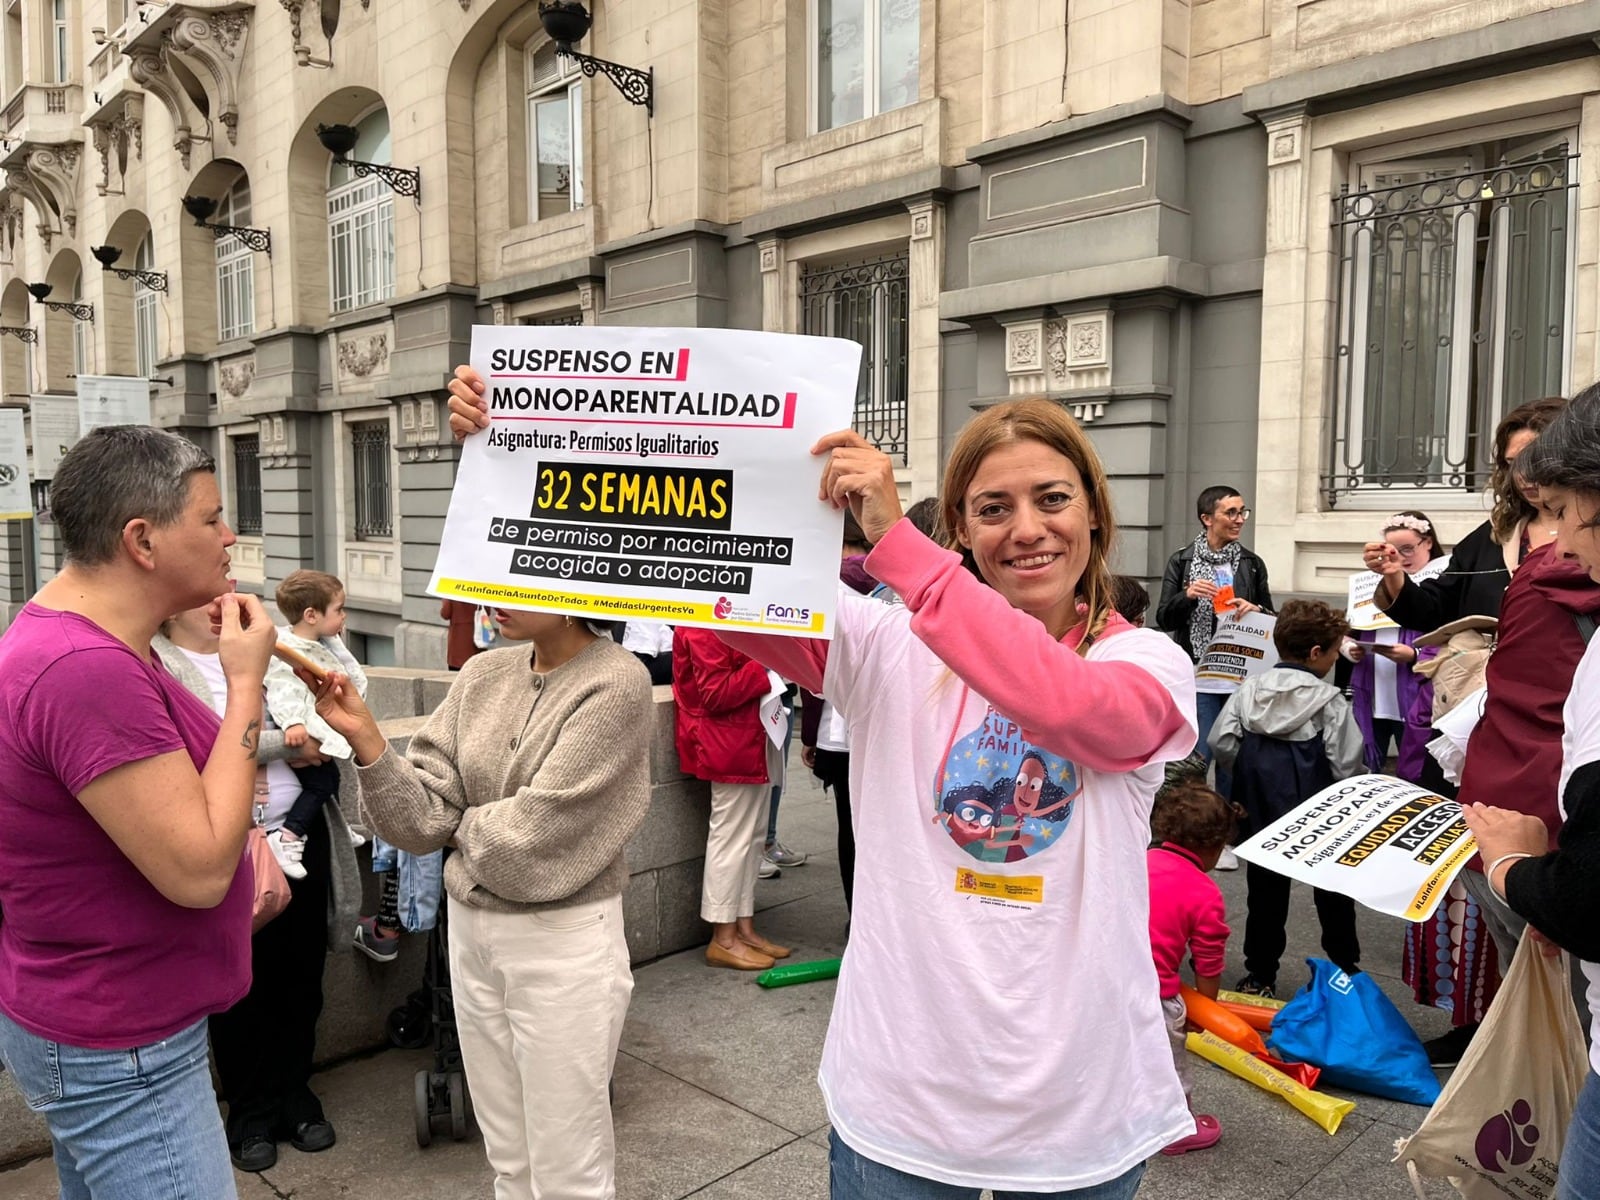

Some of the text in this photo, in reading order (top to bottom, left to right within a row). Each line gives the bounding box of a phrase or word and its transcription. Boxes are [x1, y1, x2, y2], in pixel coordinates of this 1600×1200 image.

[491, 349, 674, 374] SUSPENSO EN
[491, 387, 780, 417] MONOPARENTALIDAD
[488, 427, 719, 457] Asignatura: Permisos Igualitarios
[538, 469, 727, 519] 32 SEMANAS
[490, 518, 789, 559] de permiso por nacimiento
[517, 555, 745, 588] acogida o adopción
[455, 584, 695, 616] #LaInfanciaAsuntoDeTodos #MedidasUrgentesYa
[1261, 786, 1356, 851] SUSPENSO
[1338, 814, 1409, 866] EQUIDAD
[1400, 805, 1421, 814] Y
[1400, 802, 1463, 849] ACCESO
[1304, 823, 1364, 867] Asignatura:
